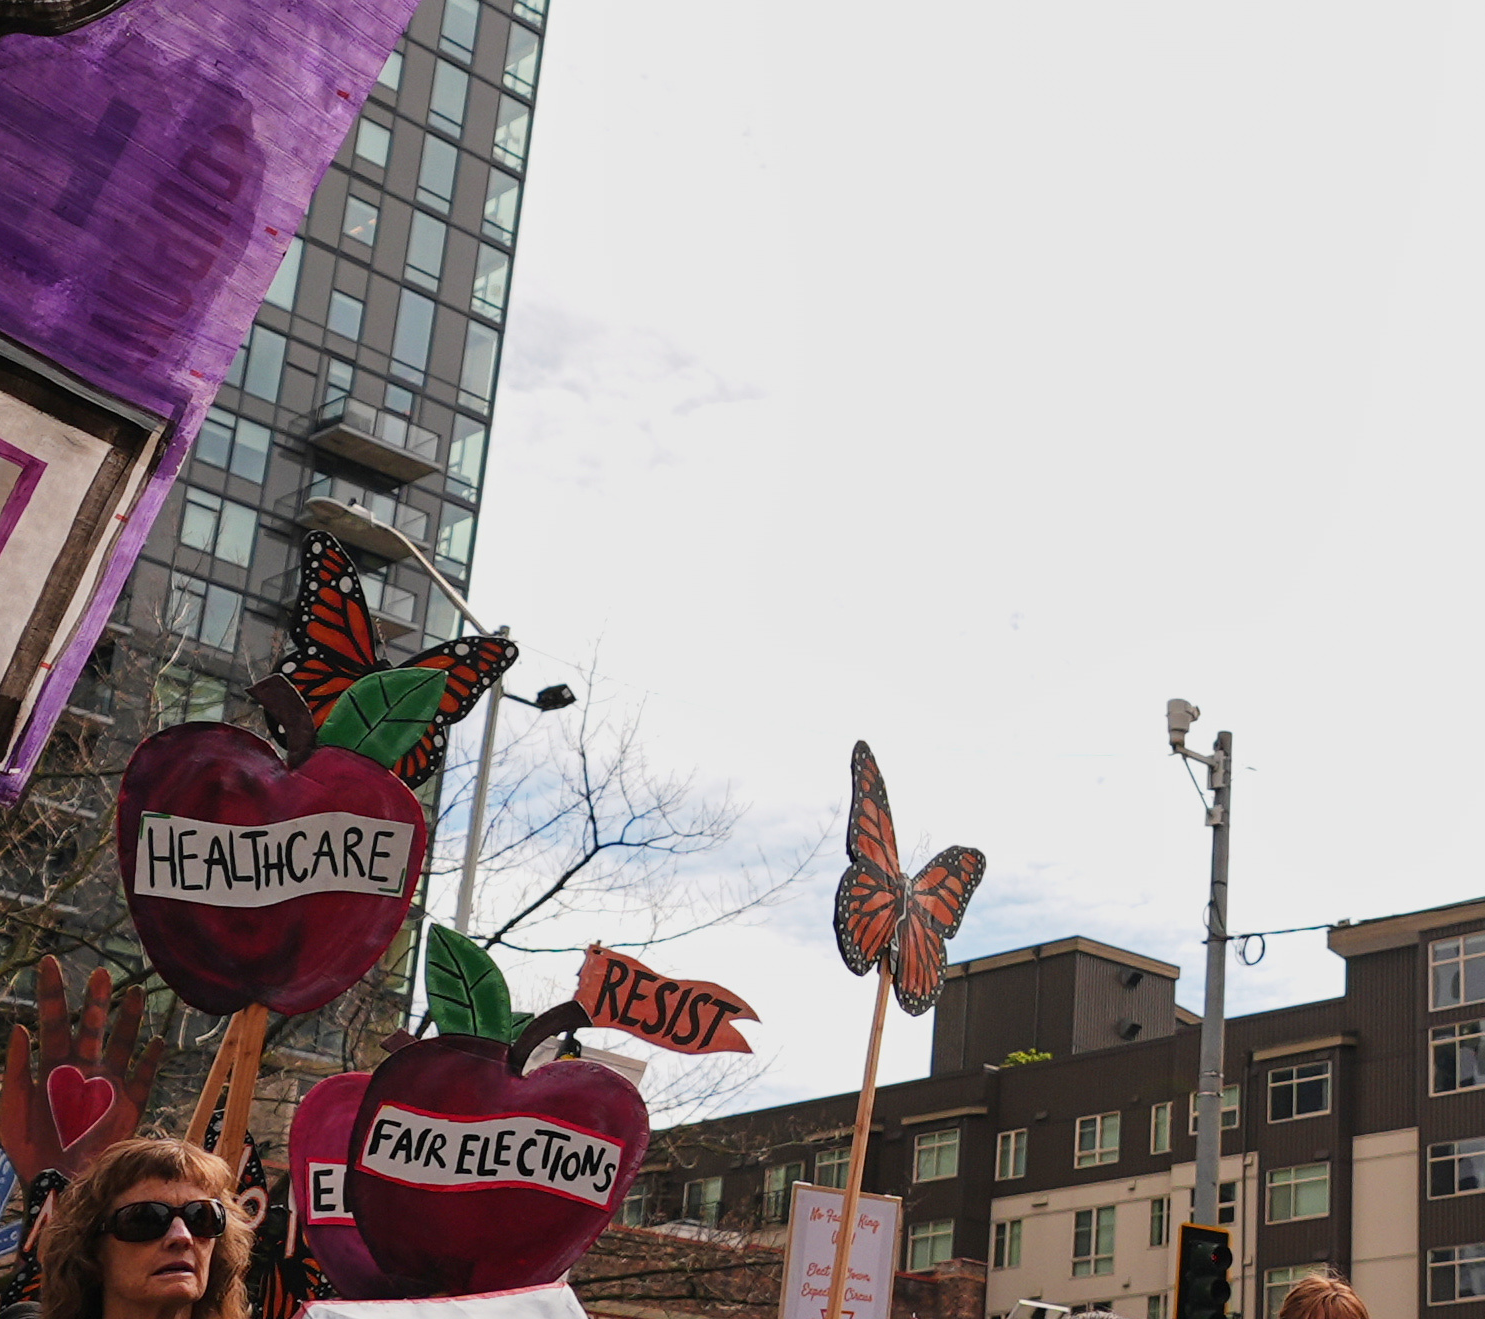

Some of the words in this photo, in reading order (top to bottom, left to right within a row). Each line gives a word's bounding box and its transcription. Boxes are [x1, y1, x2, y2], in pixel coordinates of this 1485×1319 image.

[146, 824, 395, 891] HEALTHCARE
[596, 959, 742, 1049] RESIST
[369, 1120, 447, 1171] FAIR
[455, 1129, 617, 1192] ELECTIONS
